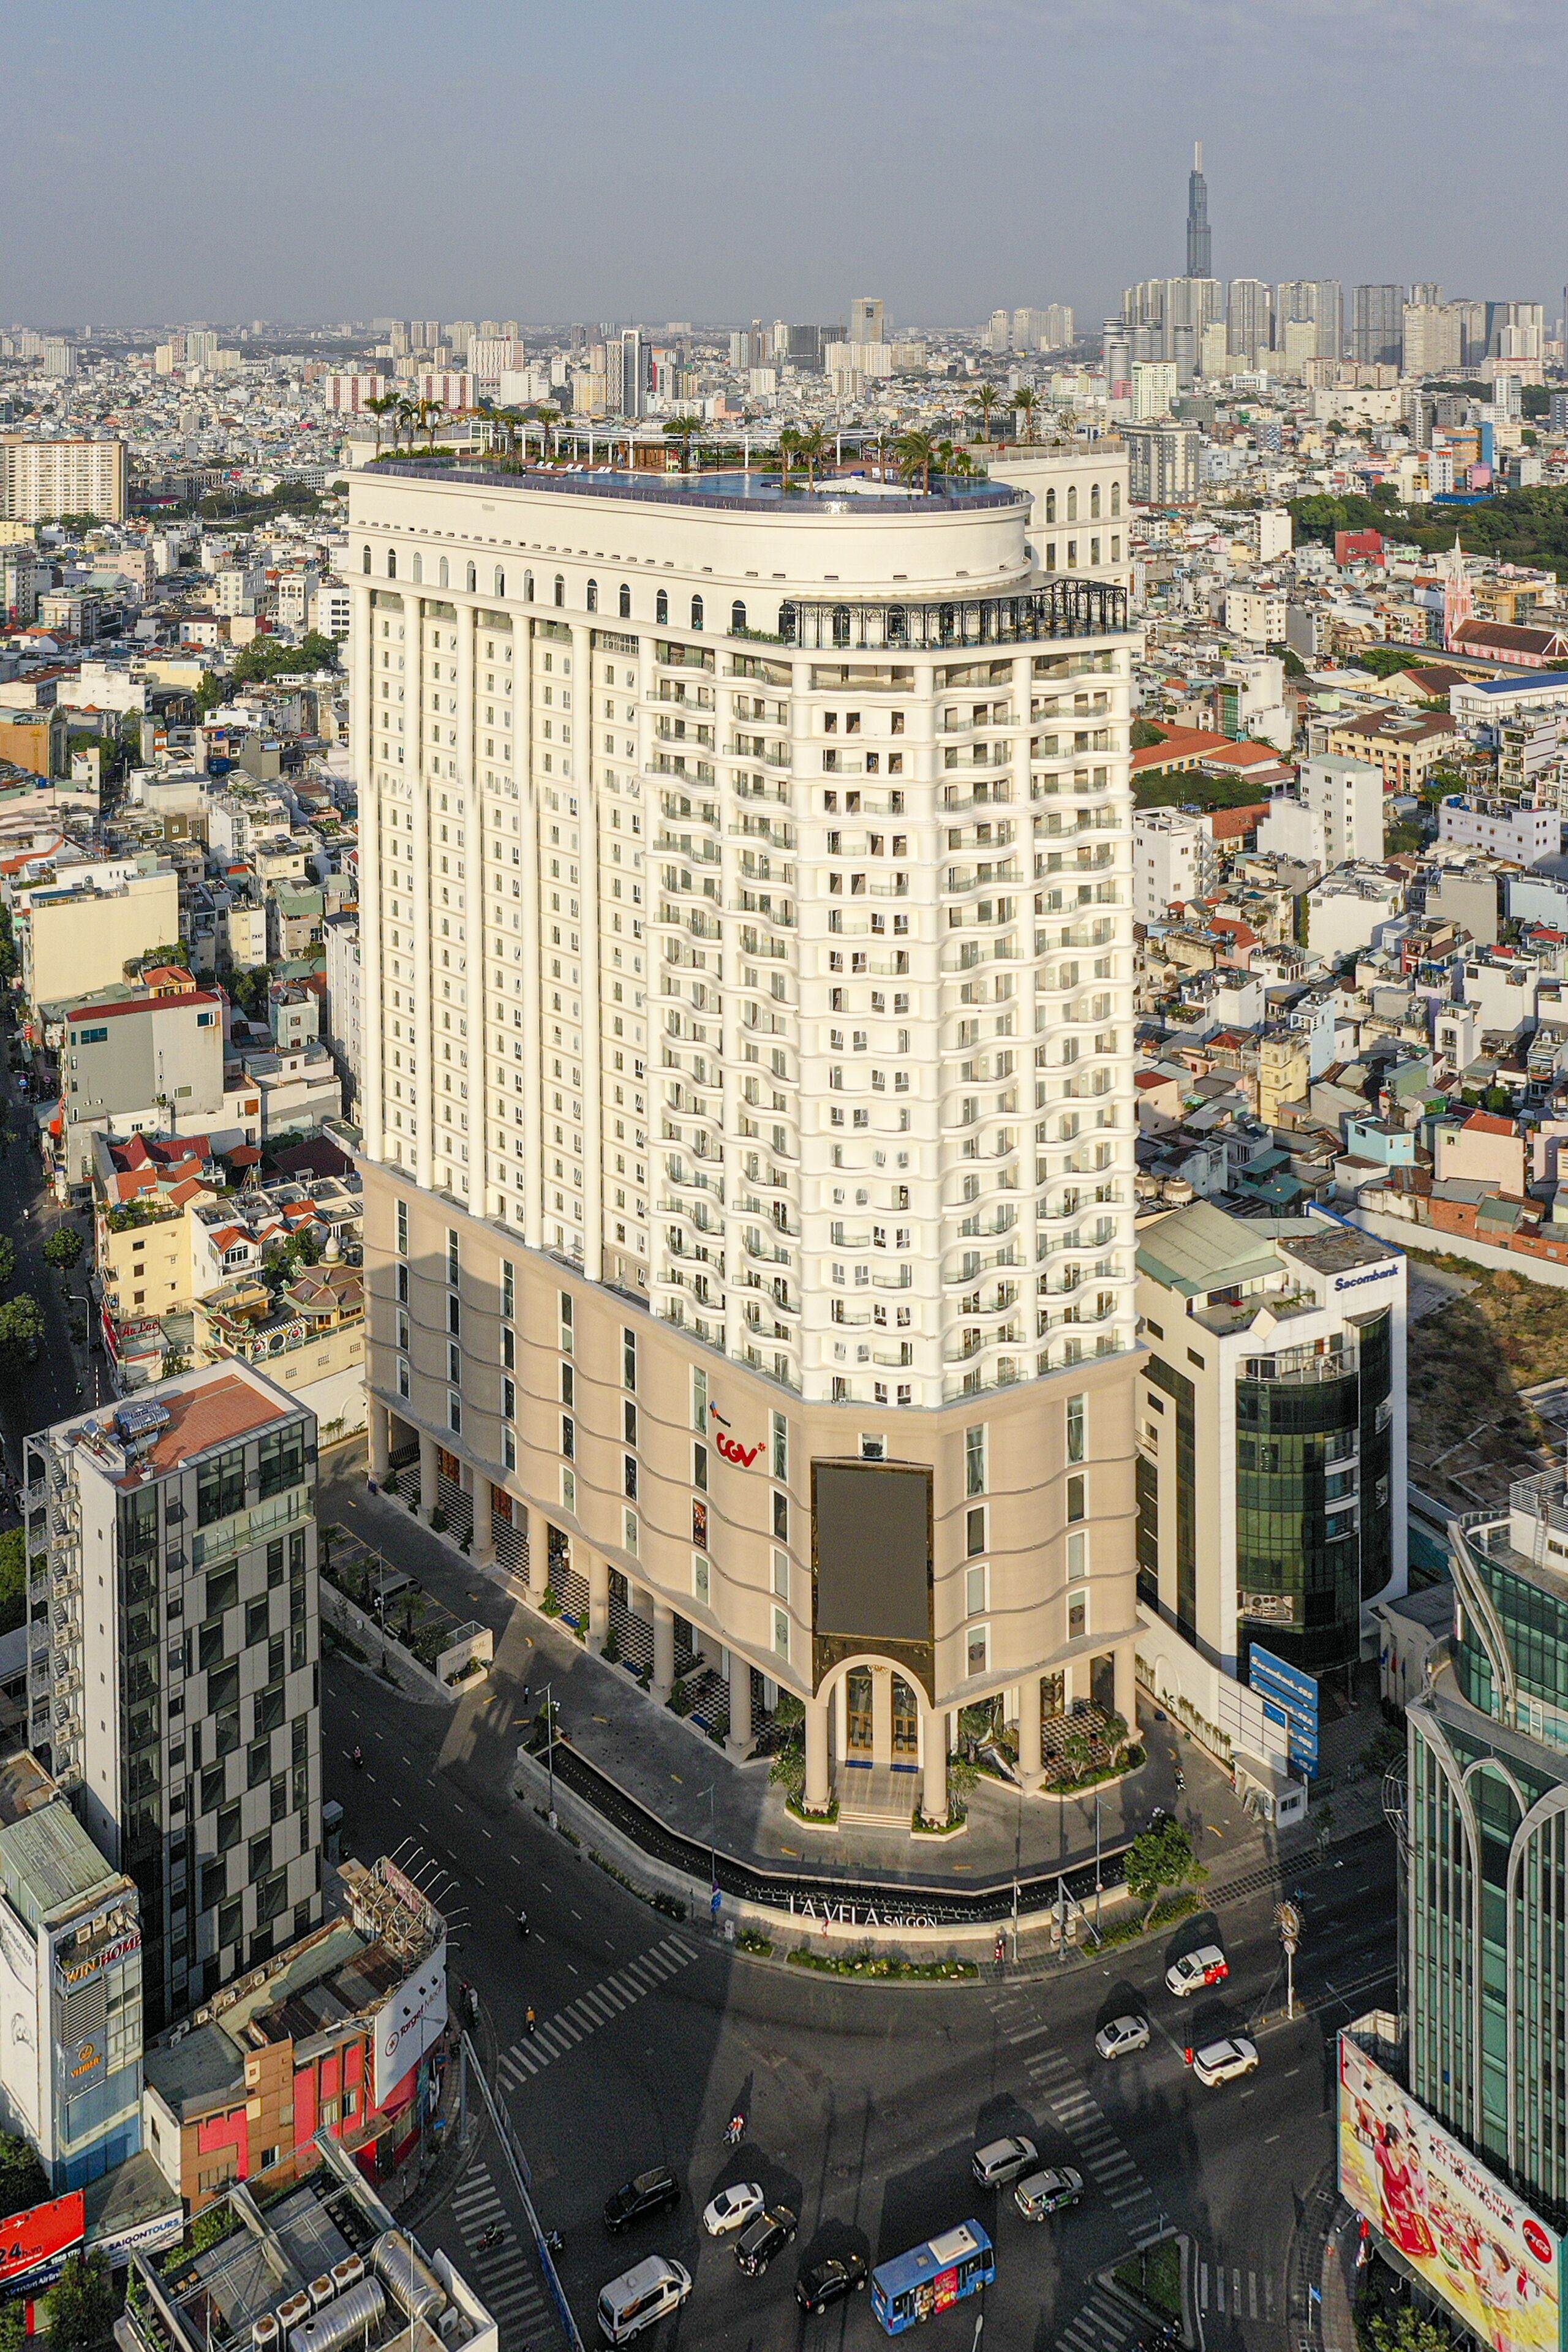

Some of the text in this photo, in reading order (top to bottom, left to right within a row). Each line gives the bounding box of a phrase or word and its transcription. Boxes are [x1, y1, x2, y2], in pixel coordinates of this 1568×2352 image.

[1334, 1264, 1399, 1292] Sacombank
[717, 1432, 758, 1468] CGV
[883, 1915, 938, 1929] SAIGON
[65, 1933, 142, 1985] WIN HOME
[400, 2003, 424, 2037] Target
[108, 2218, 179, 2252] SAIGONTOURS
[39, 2271, 61, 2285] Airlin
